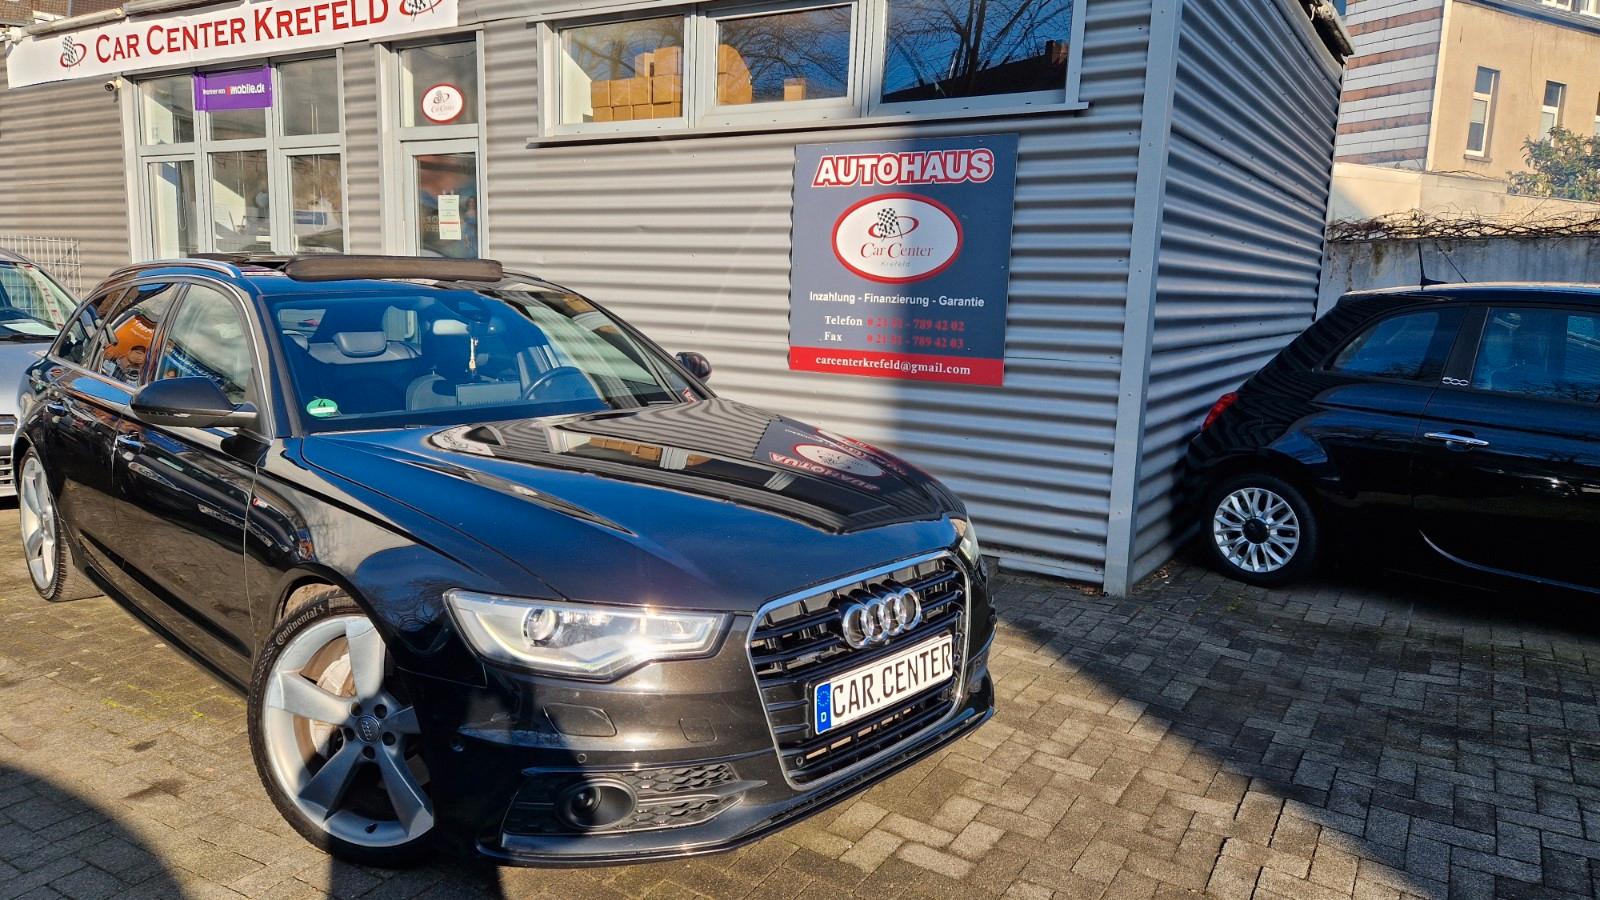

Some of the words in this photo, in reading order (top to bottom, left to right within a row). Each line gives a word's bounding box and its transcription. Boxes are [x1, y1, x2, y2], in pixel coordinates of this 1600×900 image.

[95, 34, 140, 63] CAR
[146, 18, 246, 56] CENTER
[254, 0, 389, 42] KREFELD
[812, 149, 995, 187] AUTOHAUS
[860, 242, 887, 259] Car
[887, 241, 934, 259] Center
[809, 291, 856, 304] Inzahlung
[864, 292, 930, 307] Finanzierung
[939, 295, 985, 308] Garantie
[824, 315, 863, 326] Telefon
[824, 331, 842, 342] Fax
[815, 356, 971, 375] carcenterkrefeld@gmail.com
[276, 606, 318, 645] Continental
[832, 641, 951, 719] CAR.CENTER
[820, 712, 827, 722] D
